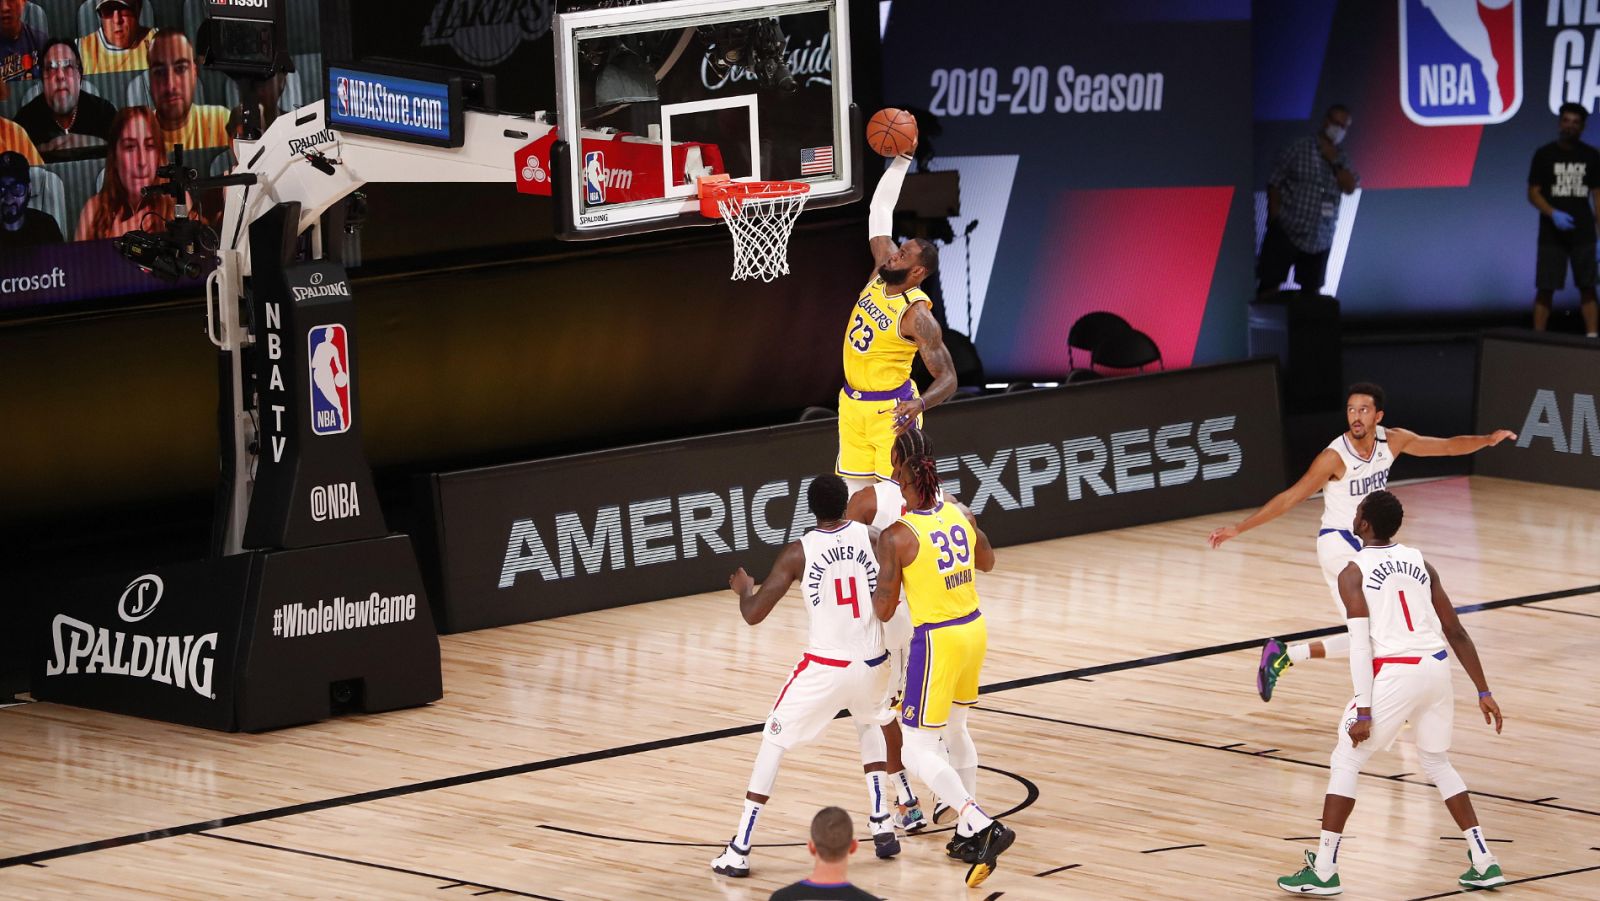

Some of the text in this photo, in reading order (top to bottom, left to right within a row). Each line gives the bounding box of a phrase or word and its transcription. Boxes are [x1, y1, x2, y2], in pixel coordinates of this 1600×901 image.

[349, 79, 443, 131] NBAStore.com
[928, 65, 1165, 117] 2019-20 Season
[1419, 63, 1477, 107] NBA
[288, 128, 335, 157] SPALDING
[579, 213, 608, 225] SPALDING
[292, 281, 350, 302] SPALDING
[857, 292, 893, 331] LAKERS
[849, 313, 875, 353] 23
[265, 302, 287, 464] NBA TV
[317, 409, 337, 428] NBA
[310, 481, 360, 522] @NBA
[929, 524, 970, 571] 39
[808, 562, 826, 607] BLACK
[821, 546, 854, 565] LIVES
[944, 568, 973, 591] HOWARD
[1366, 560, 1428, 591] LIBERATION
[272, 591, 417, 639] #WholeNewGame
[834, 576, 861, 619] 4
[1398, 590, 1415, 632] 1
[46, 613, 218, 700] SPALDING
